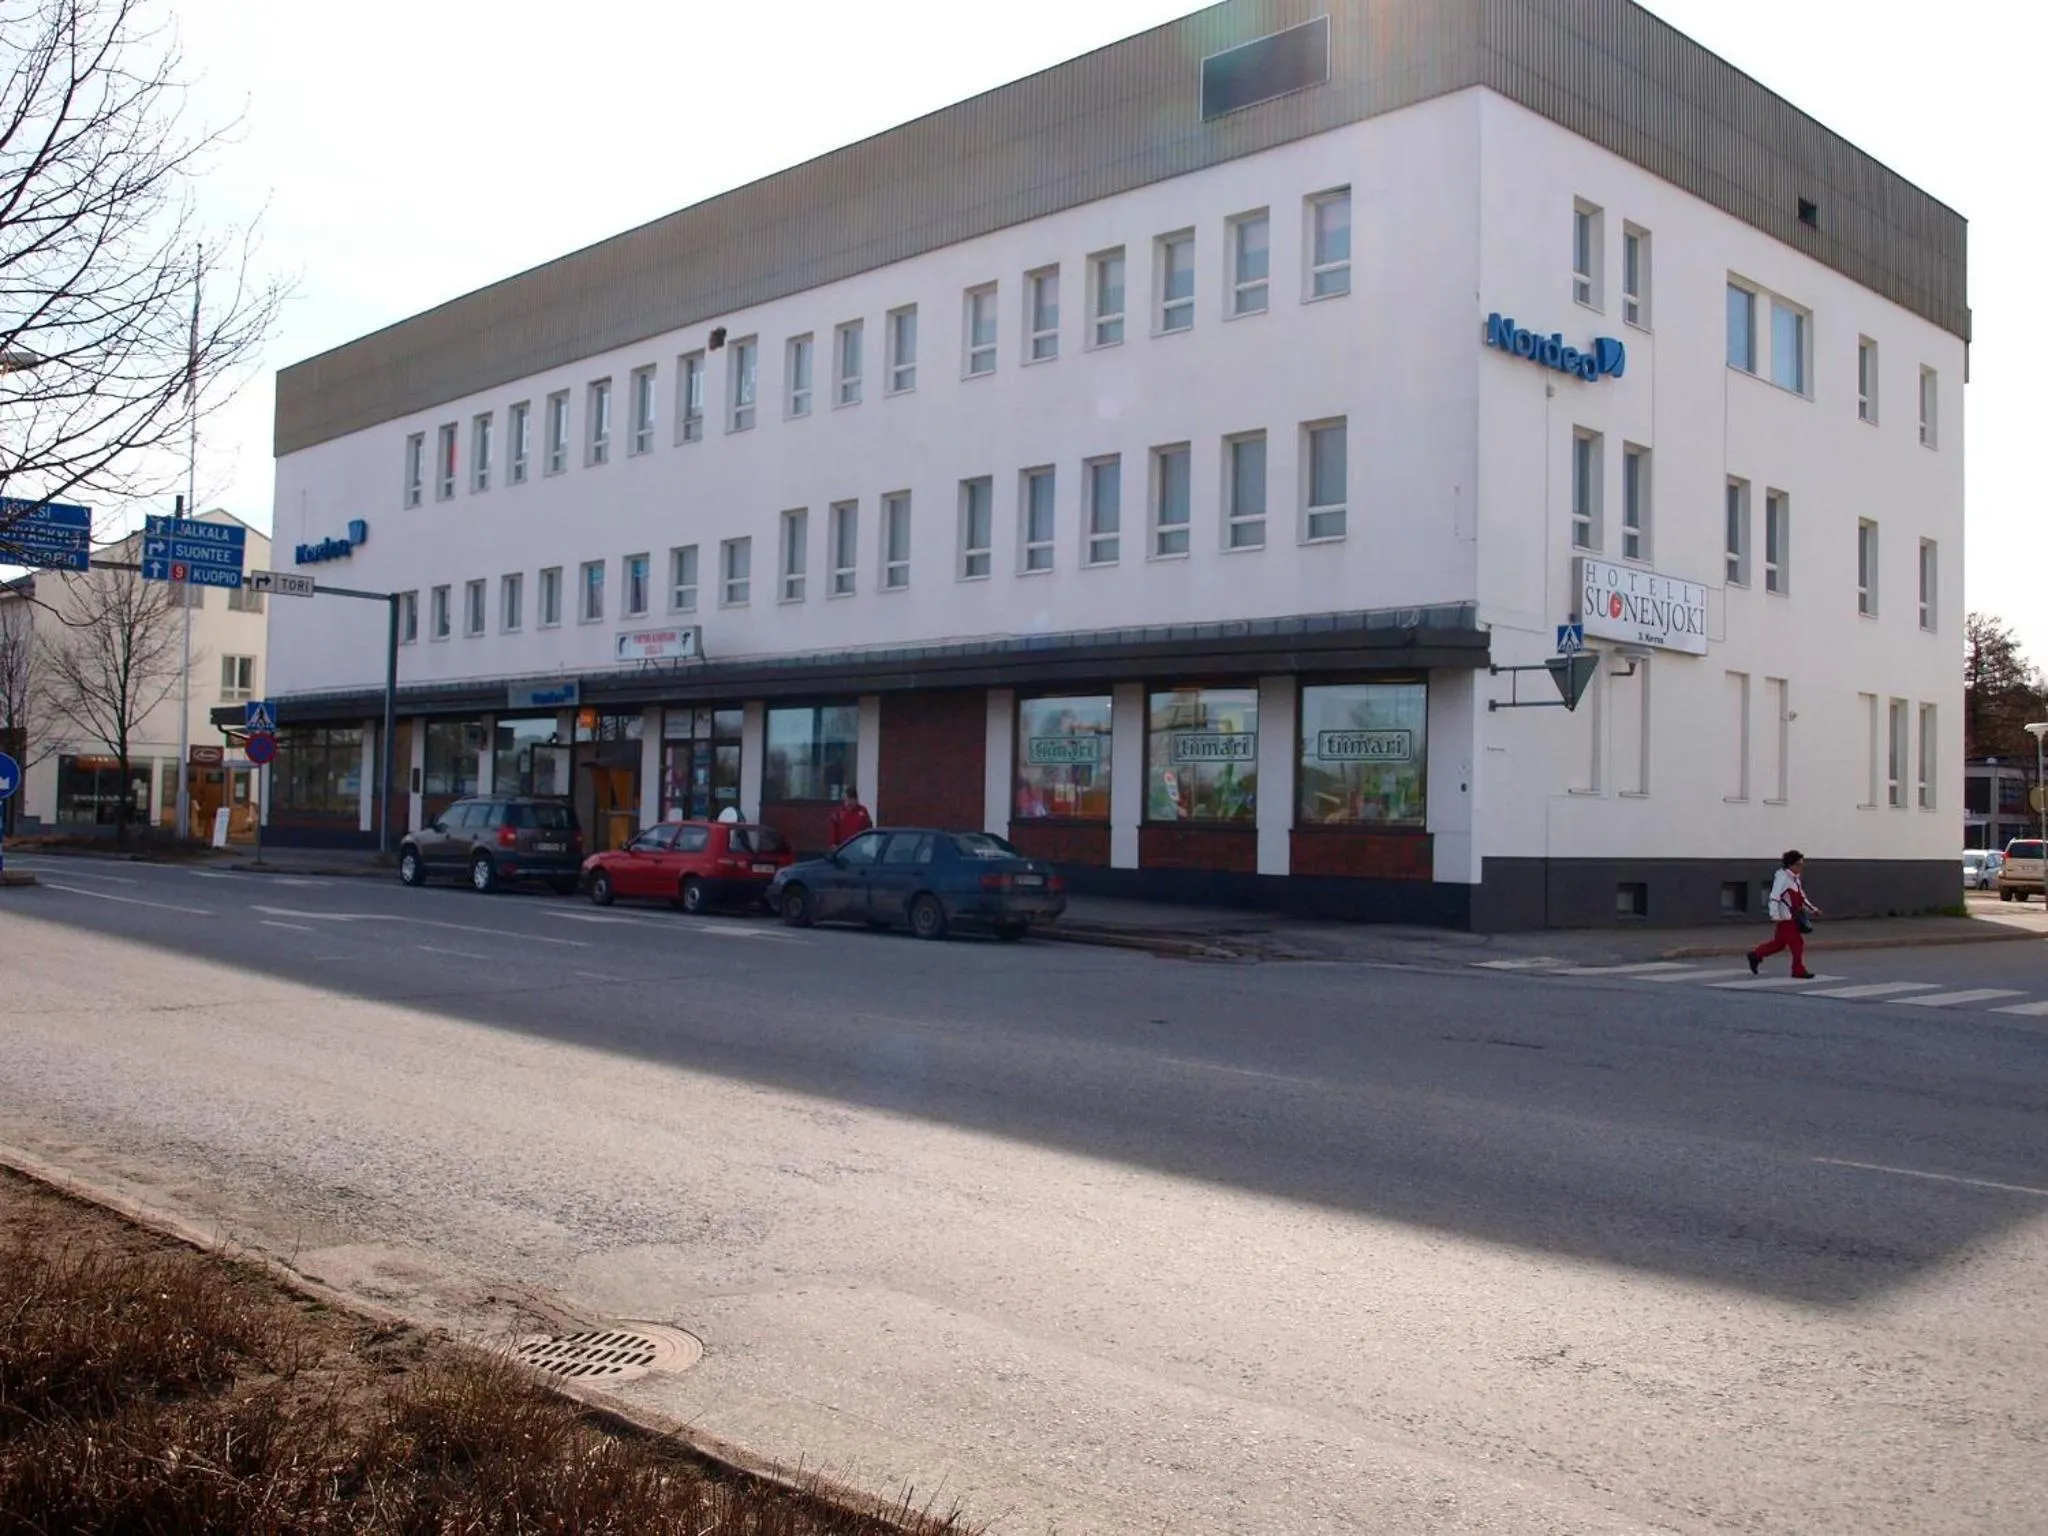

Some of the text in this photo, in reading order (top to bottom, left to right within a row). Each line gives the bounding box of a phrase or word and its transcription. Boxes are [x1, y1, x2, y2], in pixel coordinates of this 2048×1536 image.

[1487, 312, 1598, 382] Nordea
[175, 543, 232, 563] SUONTEE
[175, 565, 238, 584] 9 KUOPIO
[281, 577, 310, 593] TORI
[1585, 562, 1705, 608] HOTELLI
[1584, 585, 1705, 637] SUONENJOKI
